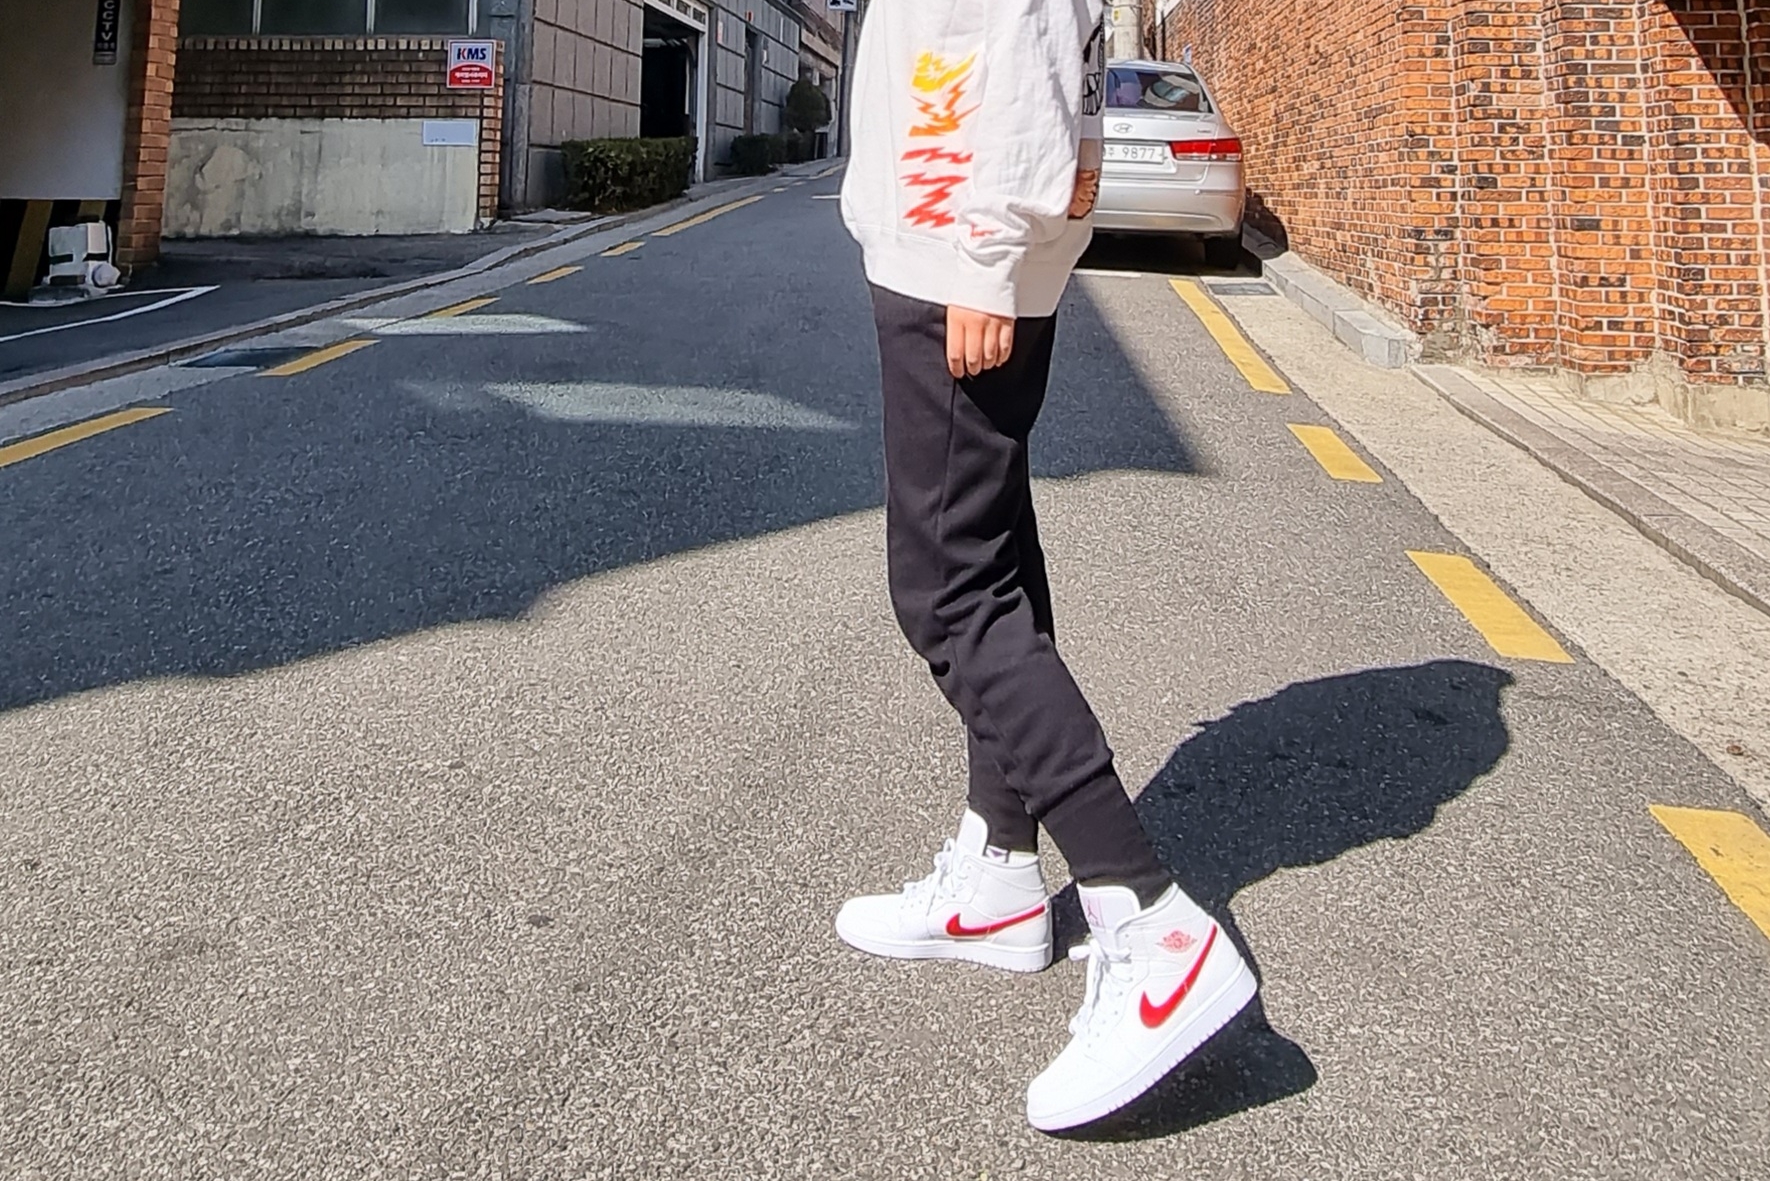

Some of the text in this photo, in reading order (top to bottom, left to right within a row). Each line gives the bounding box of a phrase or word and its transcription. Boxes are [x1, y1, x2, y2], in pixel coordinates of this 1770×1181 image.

[101, 0, 116, 41] CCTV
[456, 47, 487, 60] KMS
[1122, 146, 1156, 160] 9877
